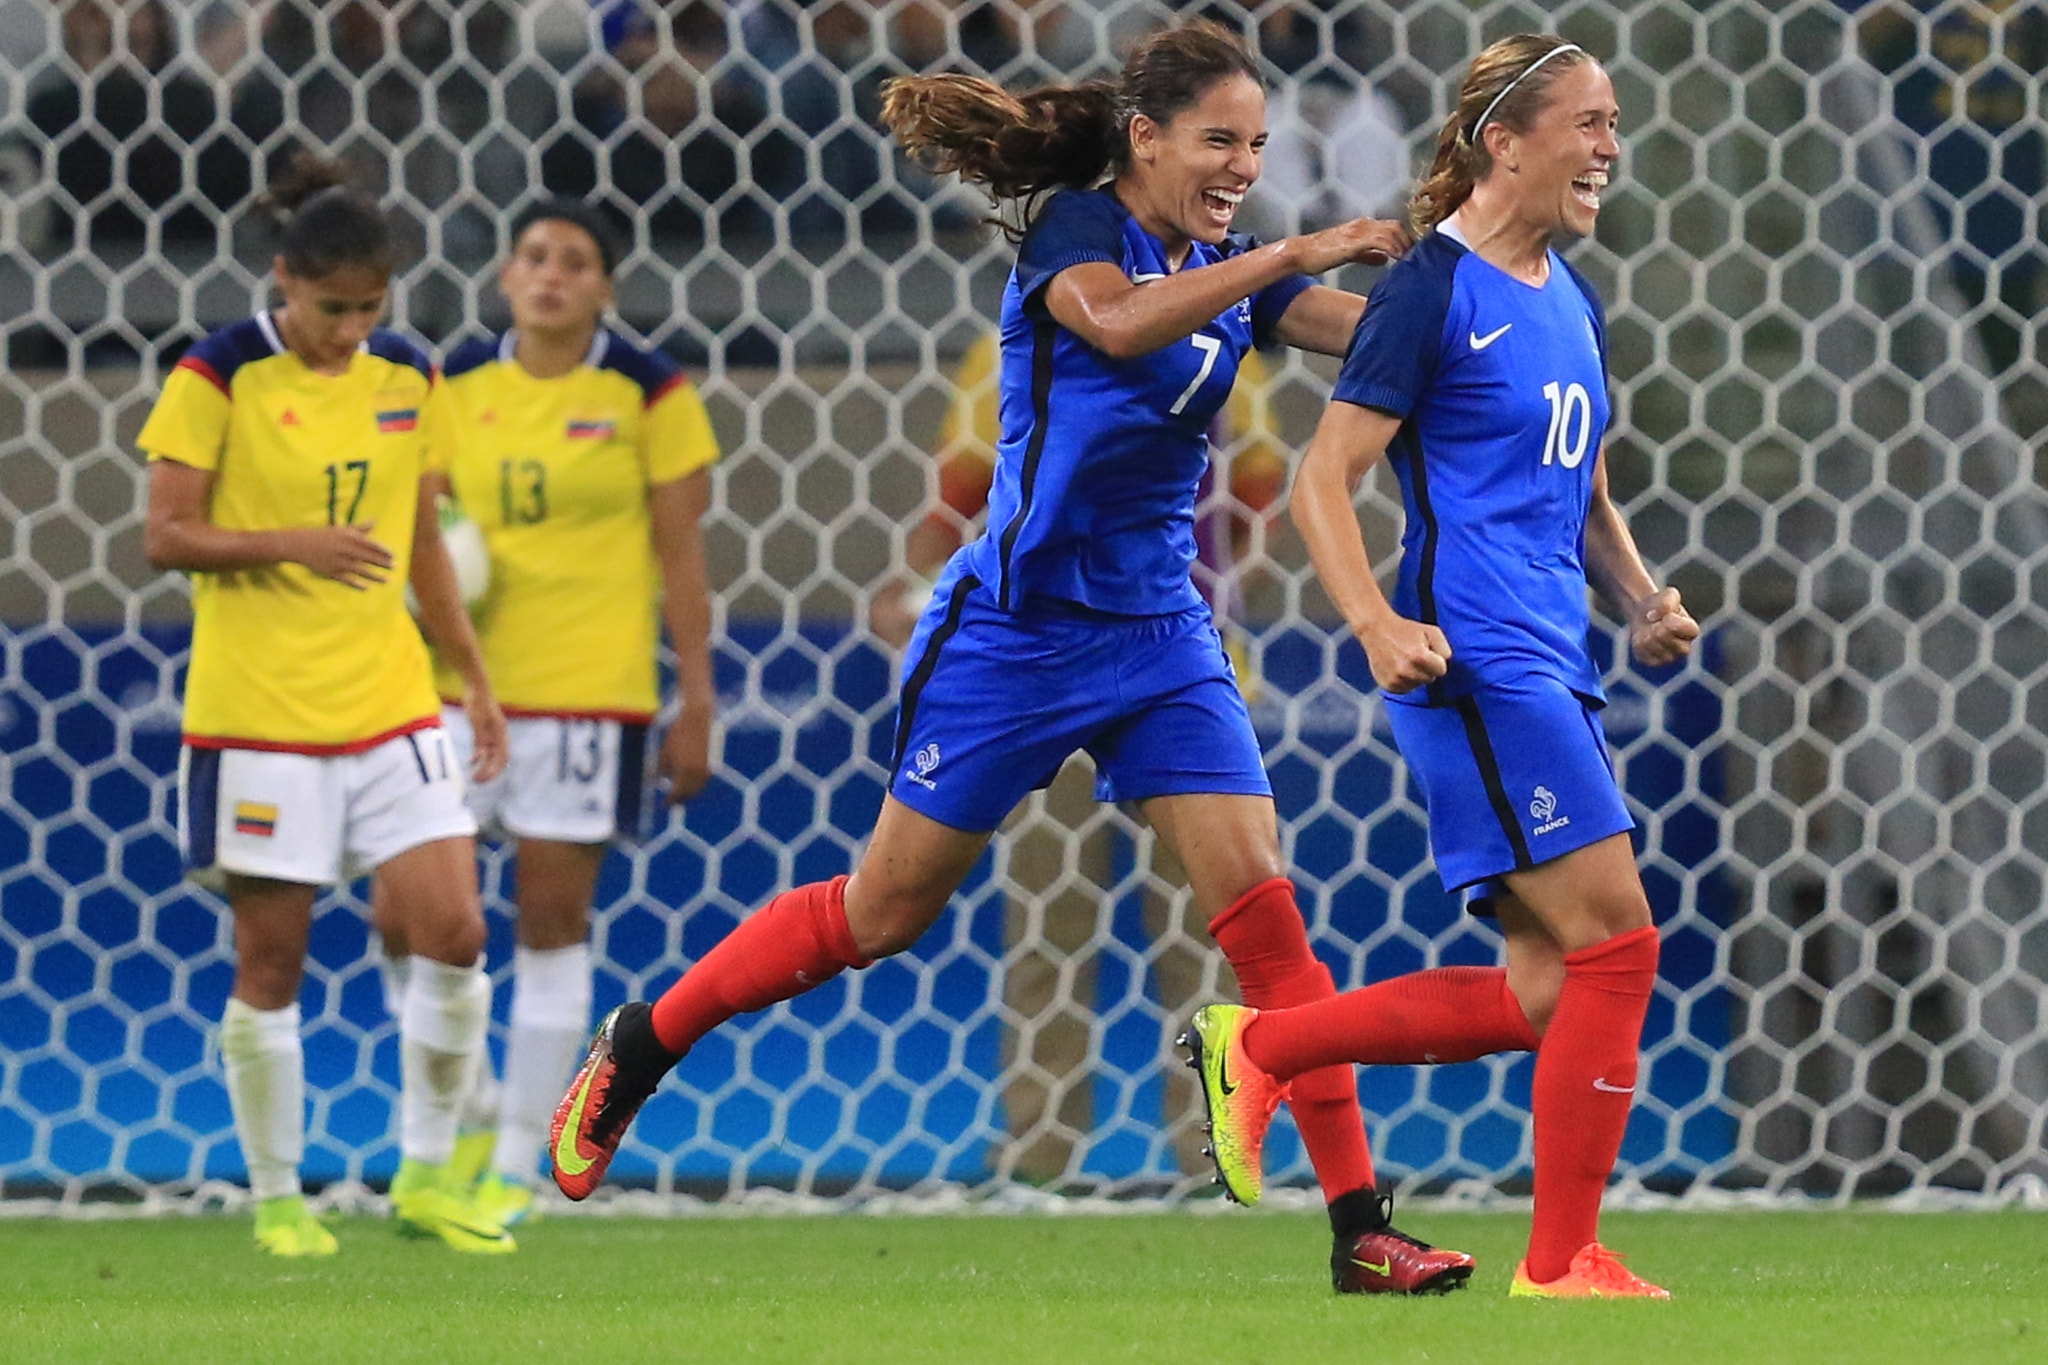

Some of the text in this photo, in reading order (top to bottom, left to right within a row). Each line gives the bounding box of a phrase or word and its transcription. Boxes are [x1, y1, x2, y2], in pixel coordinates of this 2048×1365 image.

[1169, 332, 1221, 415] 7
[1542, 381, 1591, 468] 10
[325, 461, 368, 526] 17
[501, 459, 547, 526] 13
[905, 770, 937, 790] FRANCE
[1533, 816, 1570, 836] FRANCE
